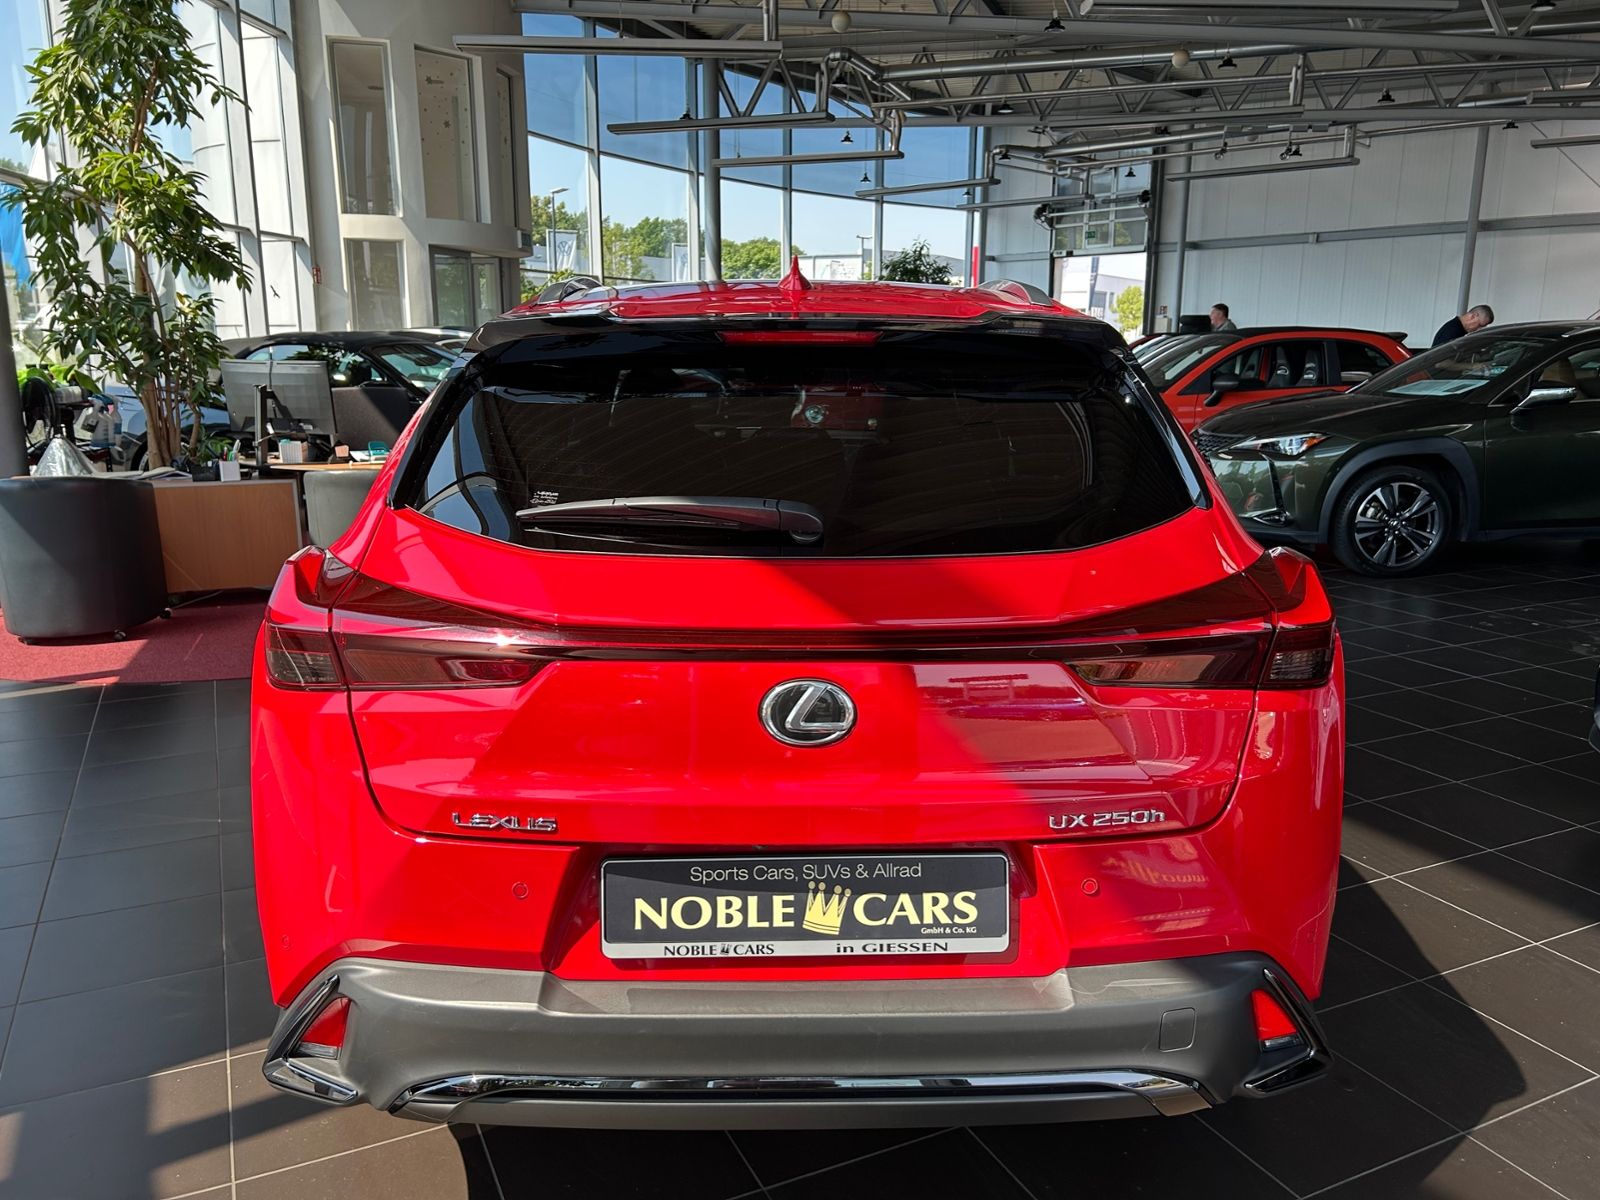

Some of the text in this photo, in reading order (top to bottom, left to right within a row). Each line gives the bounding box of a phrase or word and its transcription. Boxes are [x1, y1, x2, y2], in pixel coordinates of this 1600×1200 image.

[452, 812, 557, 831] LEXUS
[1048, 809, 1166, 829] UX 250h
[690, 862, 922, 885] Sports Cars, SUVs & Allrad
[634, 890, 978, 930] NOBLE CARS
[664, 942, 948, 957] NOBLE CARS in GIESSEN
